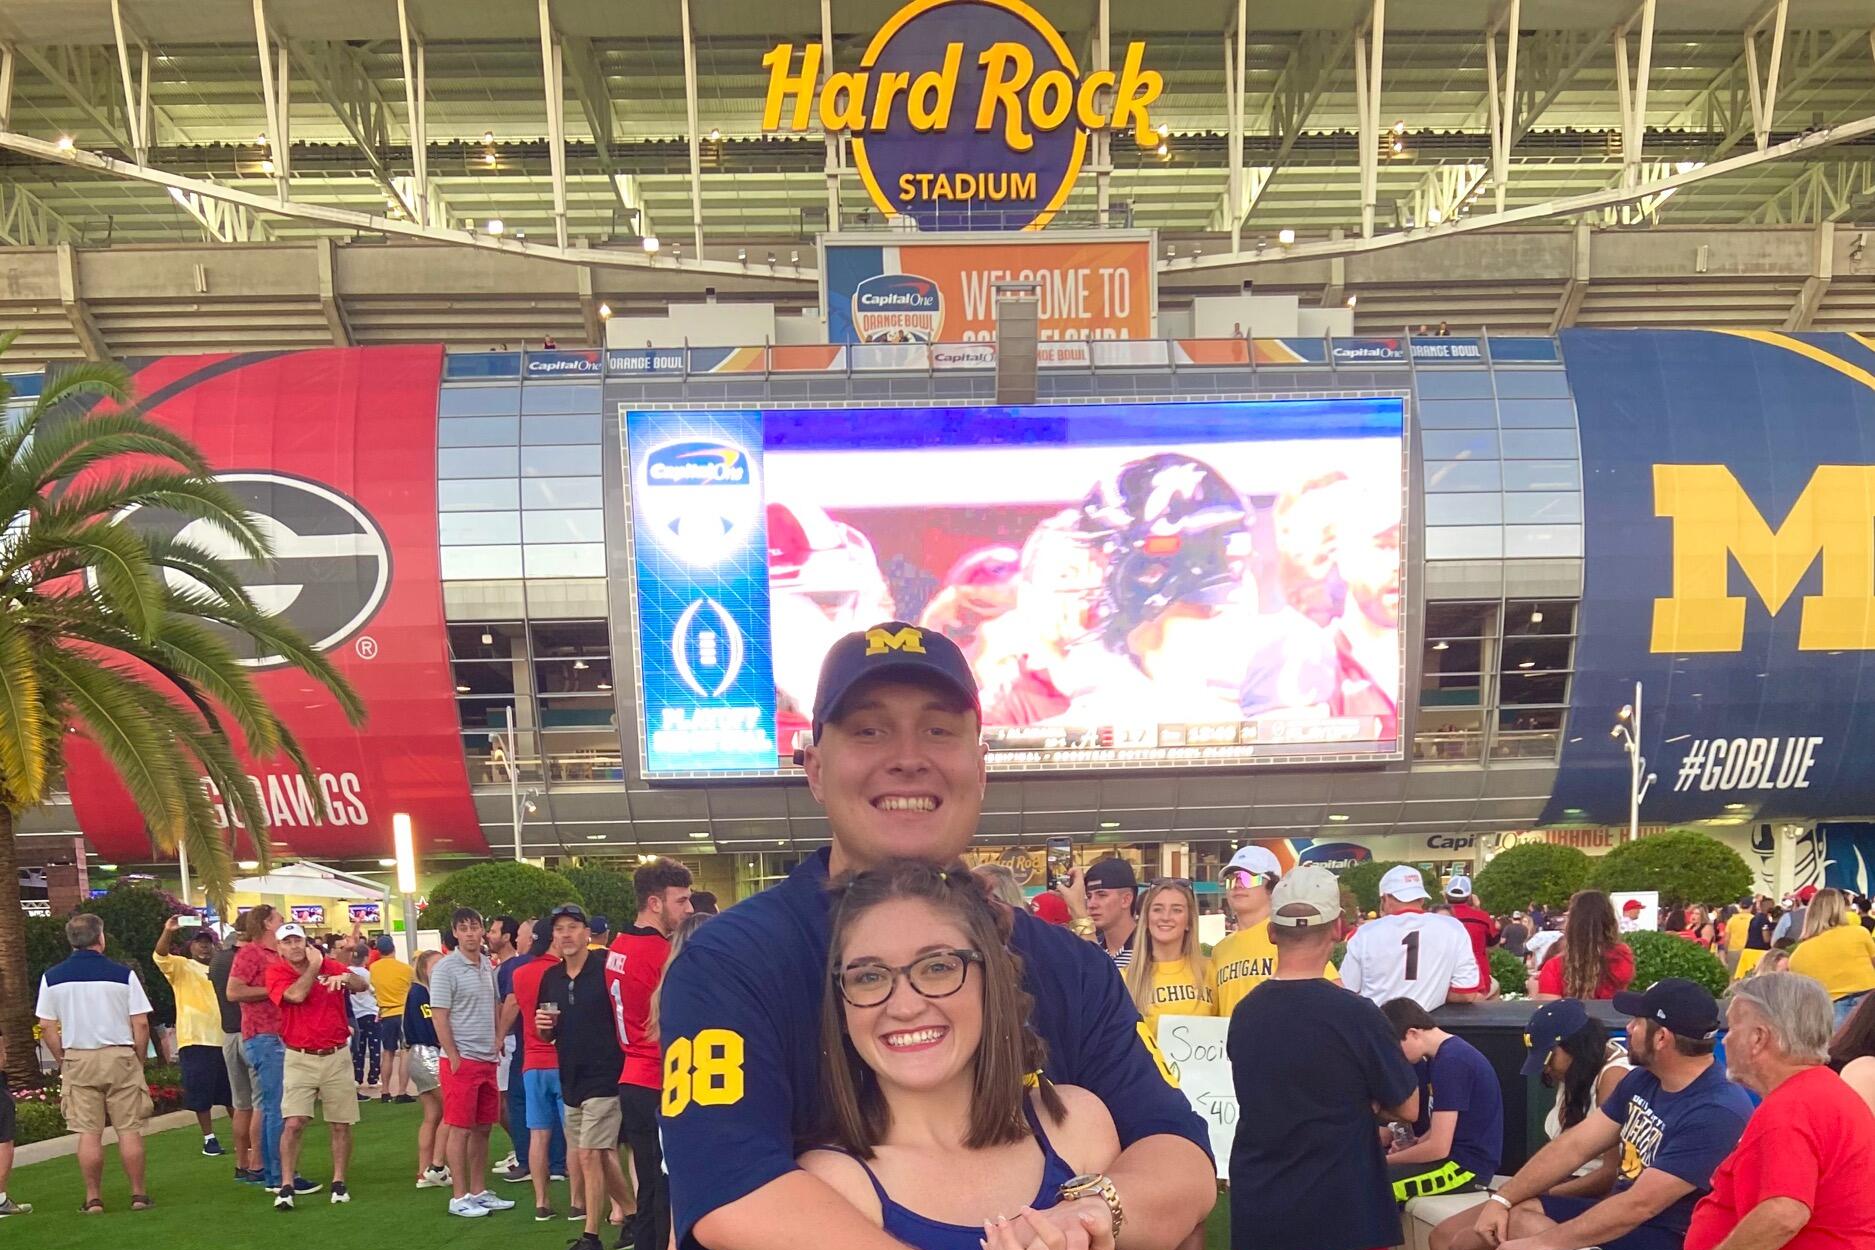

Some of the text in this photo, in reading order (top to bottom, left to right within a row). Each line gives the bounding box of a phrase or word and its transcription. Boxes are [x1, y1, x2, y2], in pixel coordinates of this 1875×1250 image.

[762, 42, 1163, 150] Hard Rock
[898, 172, 1037, 201] STADIUM
[961, 268, 1130, 321] WEOME TO
[863, 312, 934, 332] ORANGE BOWL
[610, 357, 651, 370] ORANGE
[653, 356, 684, 369] BOWL
[1057, 349, 1086, 361] BOWL
[1451, 345, 1481, 357] BOWL
[1650, 464, 1875, 653] M
[865, 627, 926, 656] M
[1674, 736, 1823, 791] #GOBLUE
[1217, 957, 1273, 987] ICHIGAN
[1401, 930, 1420, 981] 1
[611, 979, 629, 1045] 1
[1170, 1025, 1227, 1062] Soci
[661, 1028, 745, 1118] 88
[1210, 1101, 1236, 1126] 40
